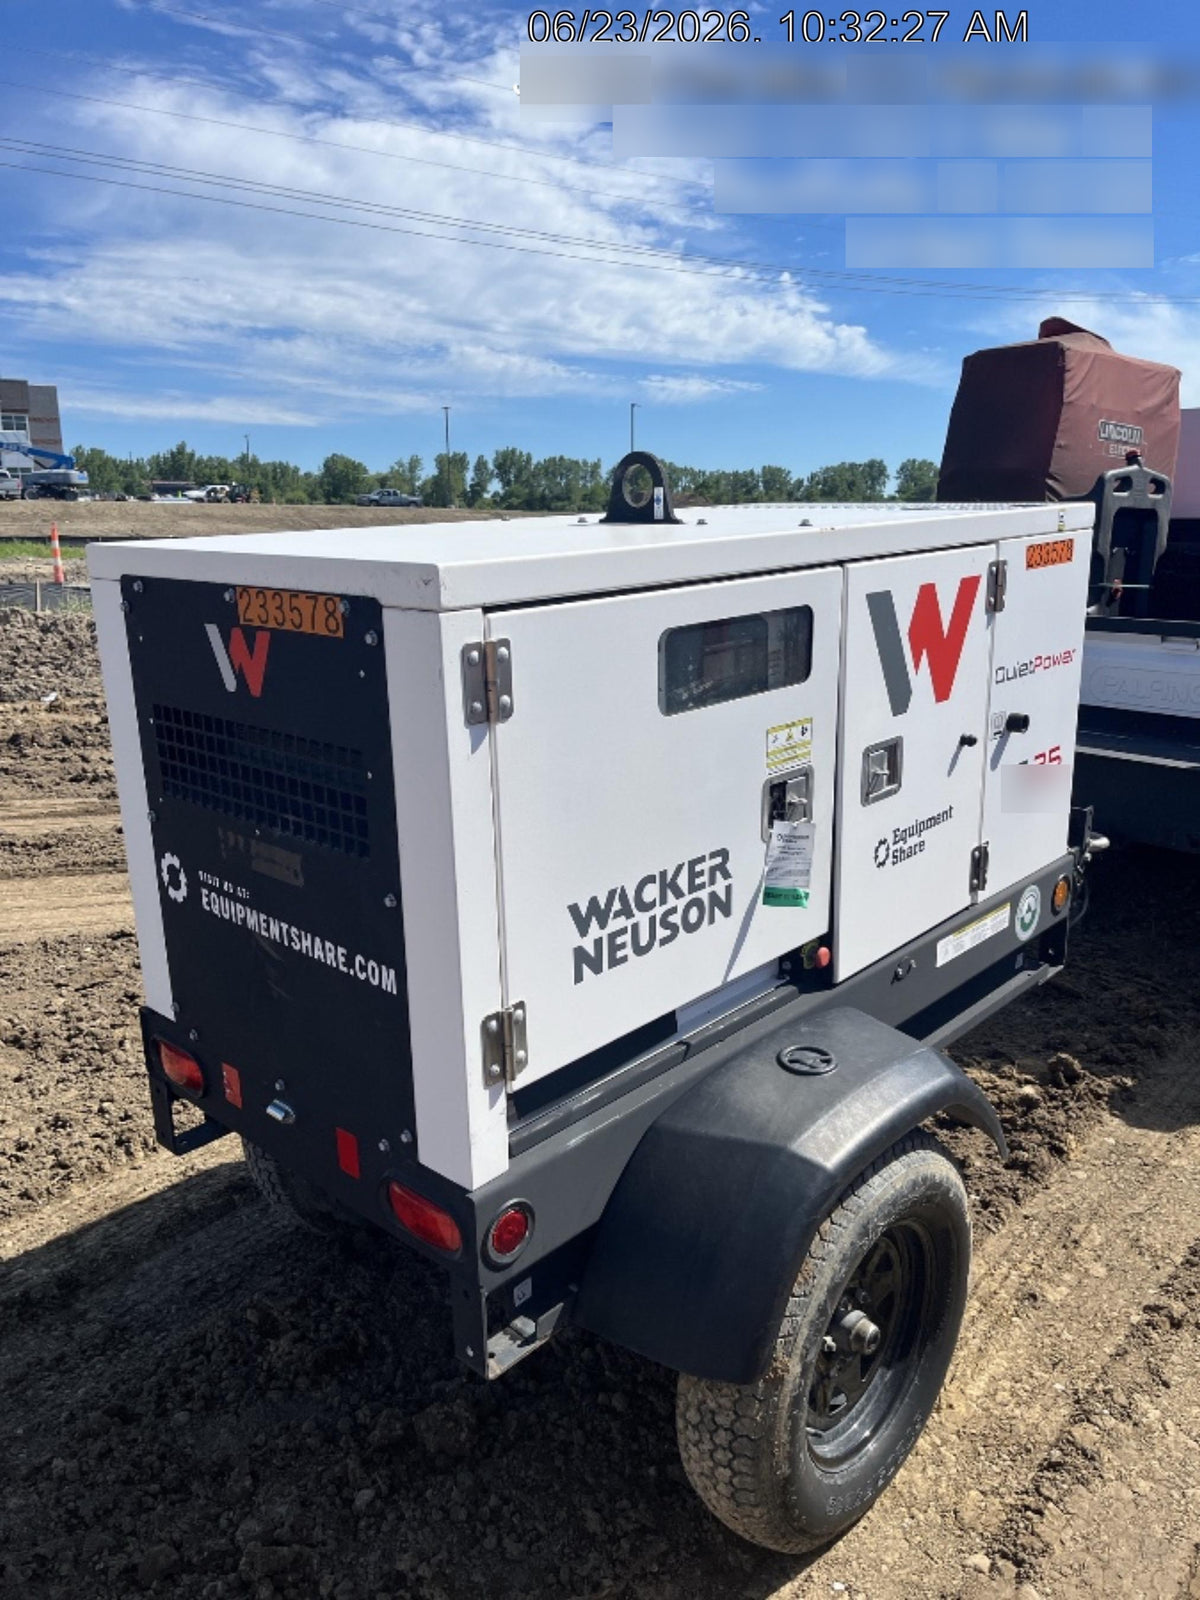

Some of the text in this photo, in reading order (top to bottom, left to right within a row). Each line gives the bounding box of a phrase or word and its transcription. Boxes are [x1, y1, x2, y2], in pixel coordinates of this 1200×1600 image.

[1099, 422, 1141, 445] LINCOLN
[238, 587, 340, 634] 233578
[995, 648, 1077, 685] QuietPower
[891, 804, 954, 845] Equipment
[891, 840, 925, 866] Share
[567, 847, 732, 940] WACKER
[200, 887, 397, 996] EQUIPMENTSHARE.COM
[573, 883, 732, 986] NEUSON
